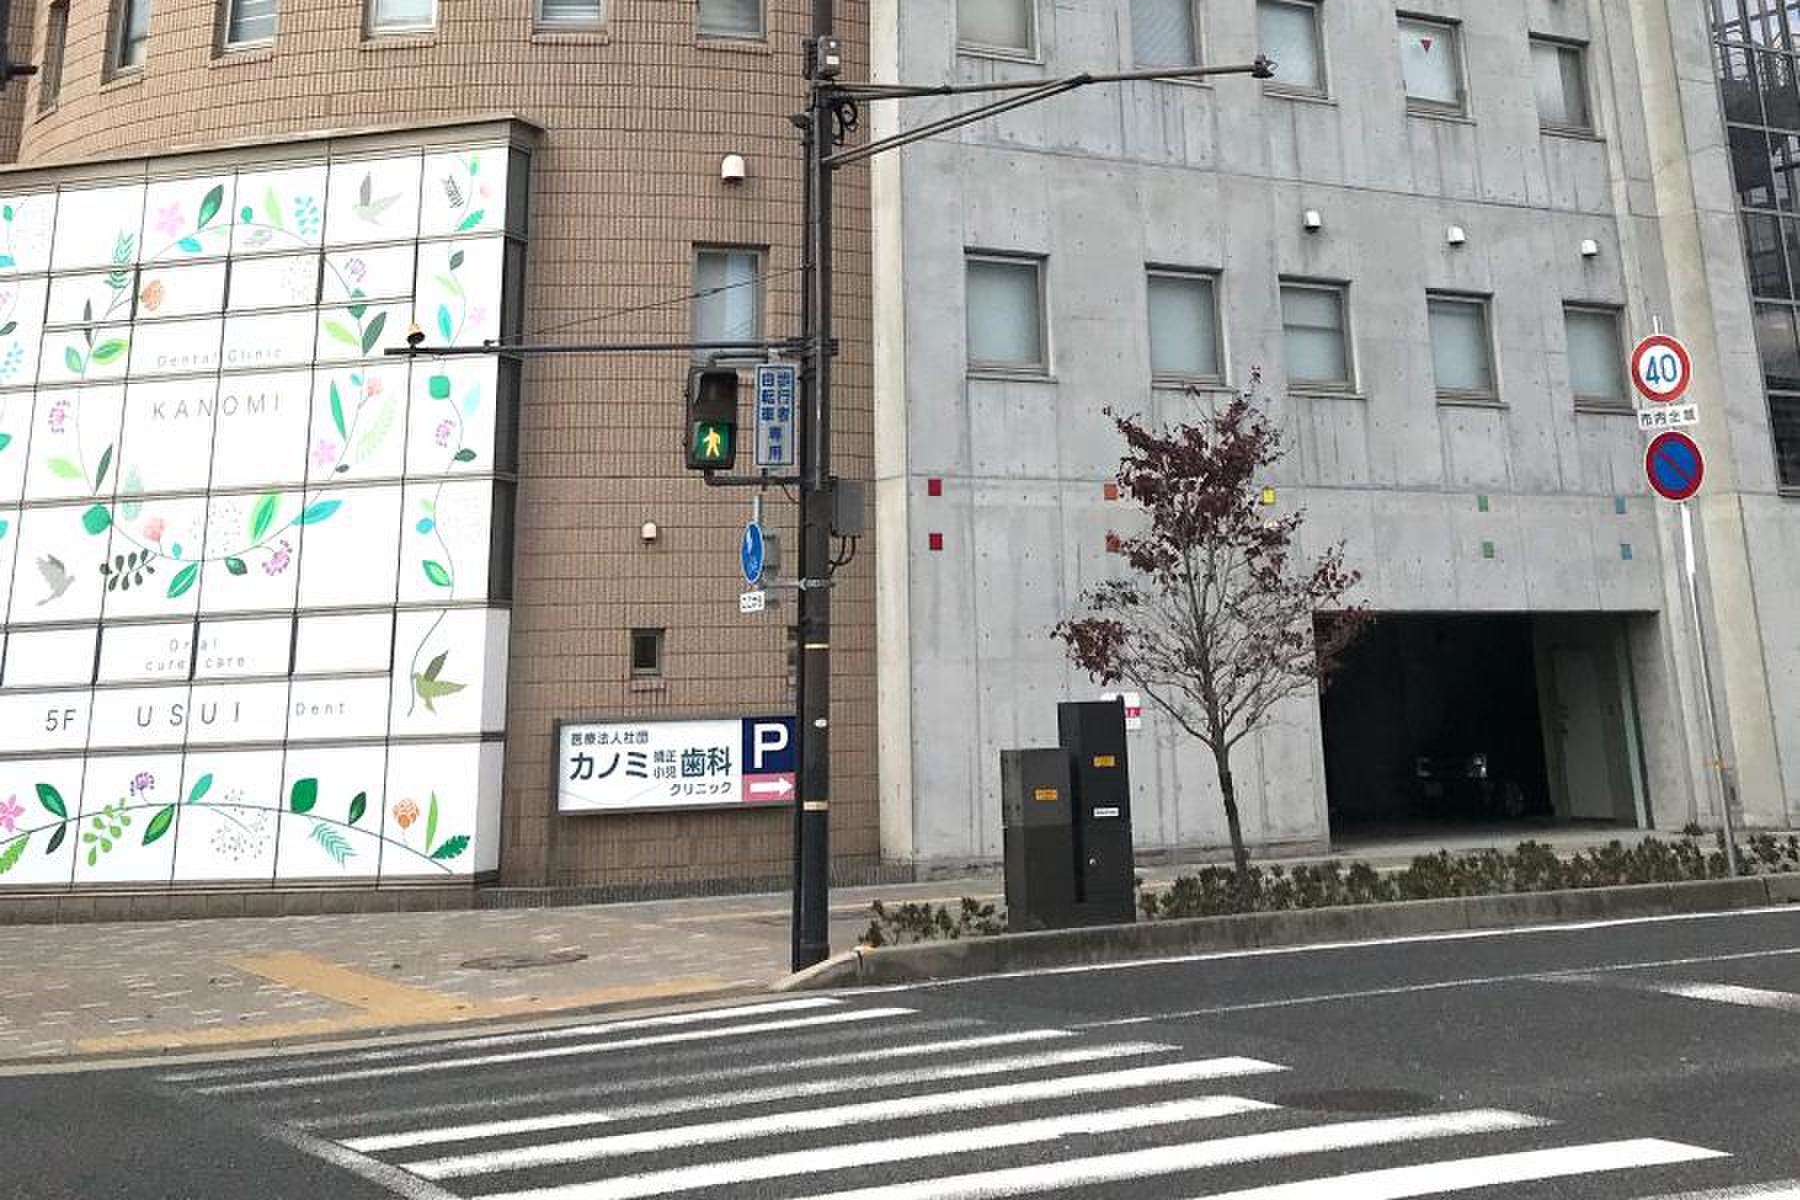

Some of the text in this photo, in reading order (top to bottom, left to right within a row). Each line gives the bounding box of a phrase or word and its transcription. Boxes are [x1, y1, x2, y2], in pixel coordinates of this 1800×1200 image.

[1646, 354, 1677, 384] 40
[153, 391, 280, 420] KANOMI
[45, 709, 77, 732] 5F
[136, 702, 241, 728] USUI
[571, 730, 649, 746] 医療法人社団
[753, 723, 789, 769] P
[569, 751, 649, 781] カノミ
[681, 746, 732, 778] 歯科
[669, 781, 732, 797] クリニック
